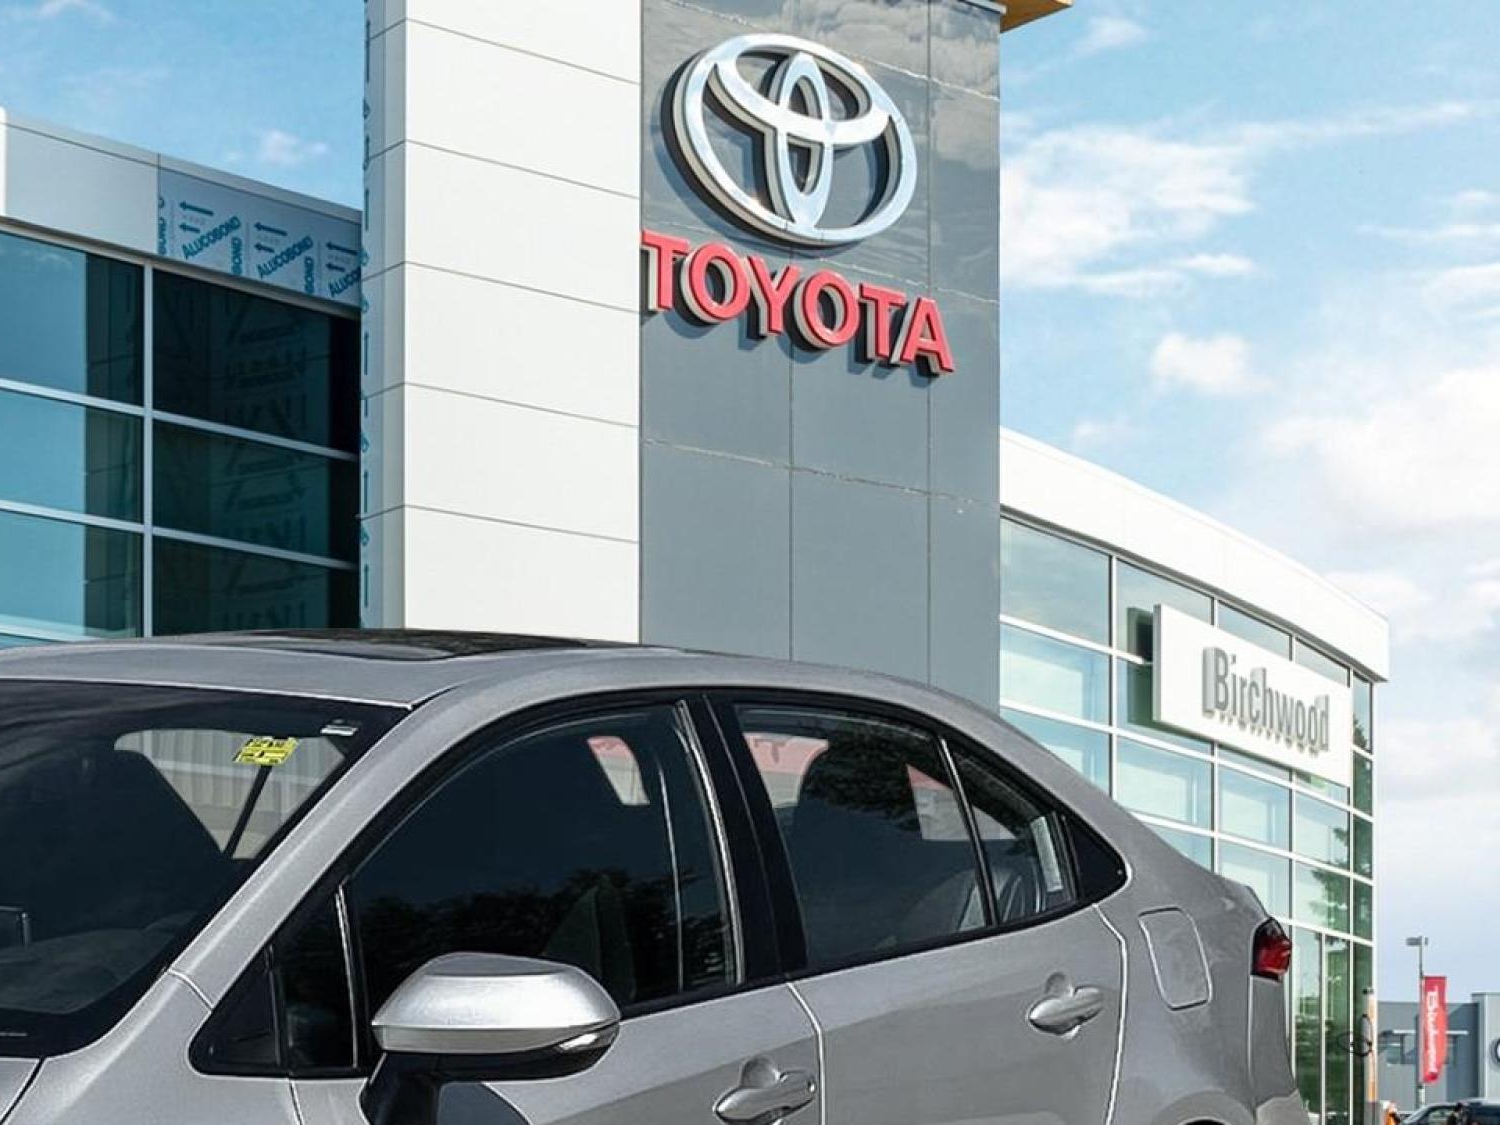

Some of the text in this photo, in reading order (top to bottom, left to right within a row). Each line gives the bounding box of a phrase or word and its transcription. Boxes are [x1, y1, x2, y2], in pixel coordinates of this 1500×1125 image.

[182, 215, 241, 260] ALUCOBOND
[257, 235, 314, 280] ALUCOBOND
[641, 230, 955, 373] TOYOTA
[1209, 647, 1330, 753] Birchwood
